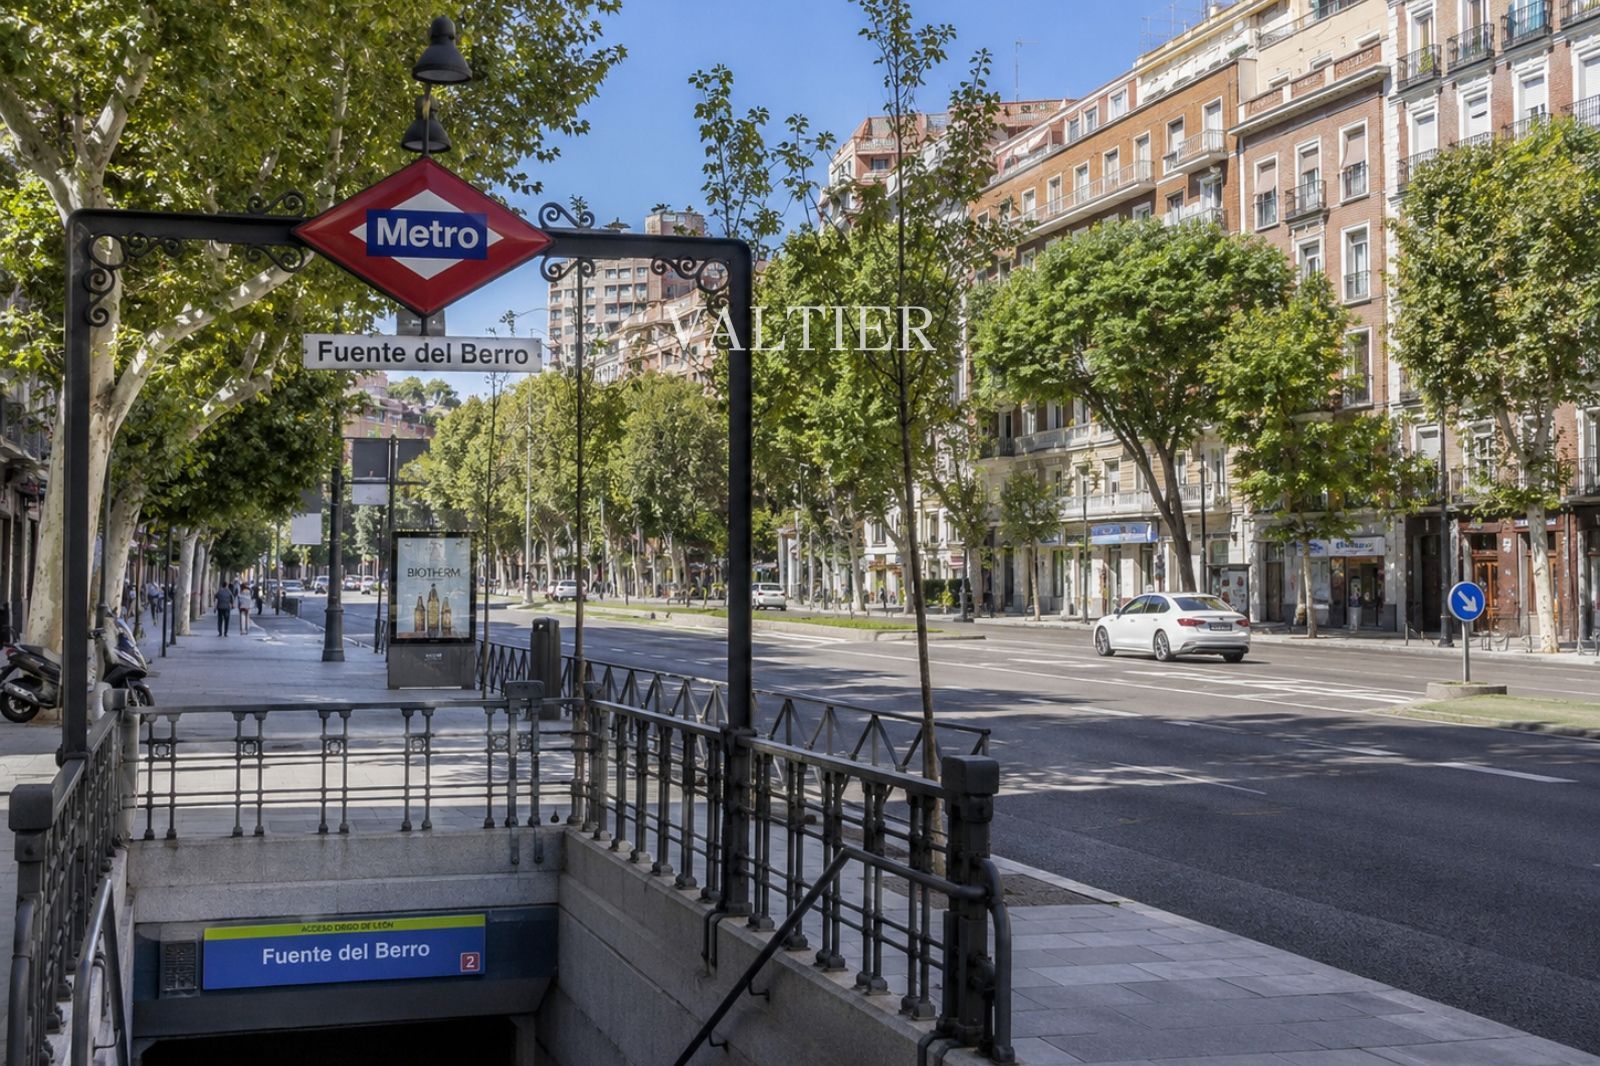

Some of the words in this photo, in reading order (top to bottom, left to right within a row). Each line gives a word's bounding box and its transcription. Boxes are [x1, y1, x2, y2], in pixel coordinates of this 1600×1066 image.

[376, 217, 480, 249] Metro
[317, 341, 407, 363] Fuente
[414, 342, 452, 364] del
[461, 343, 529, 365] Berro
[407, 567, 461, 578] BIOTHERM
[262, 946, 332, 965] Fuente
[338, 943, 368, 961] del
[375, 942, 430, 959] Berro
[465, 956, 475, 968] 2
